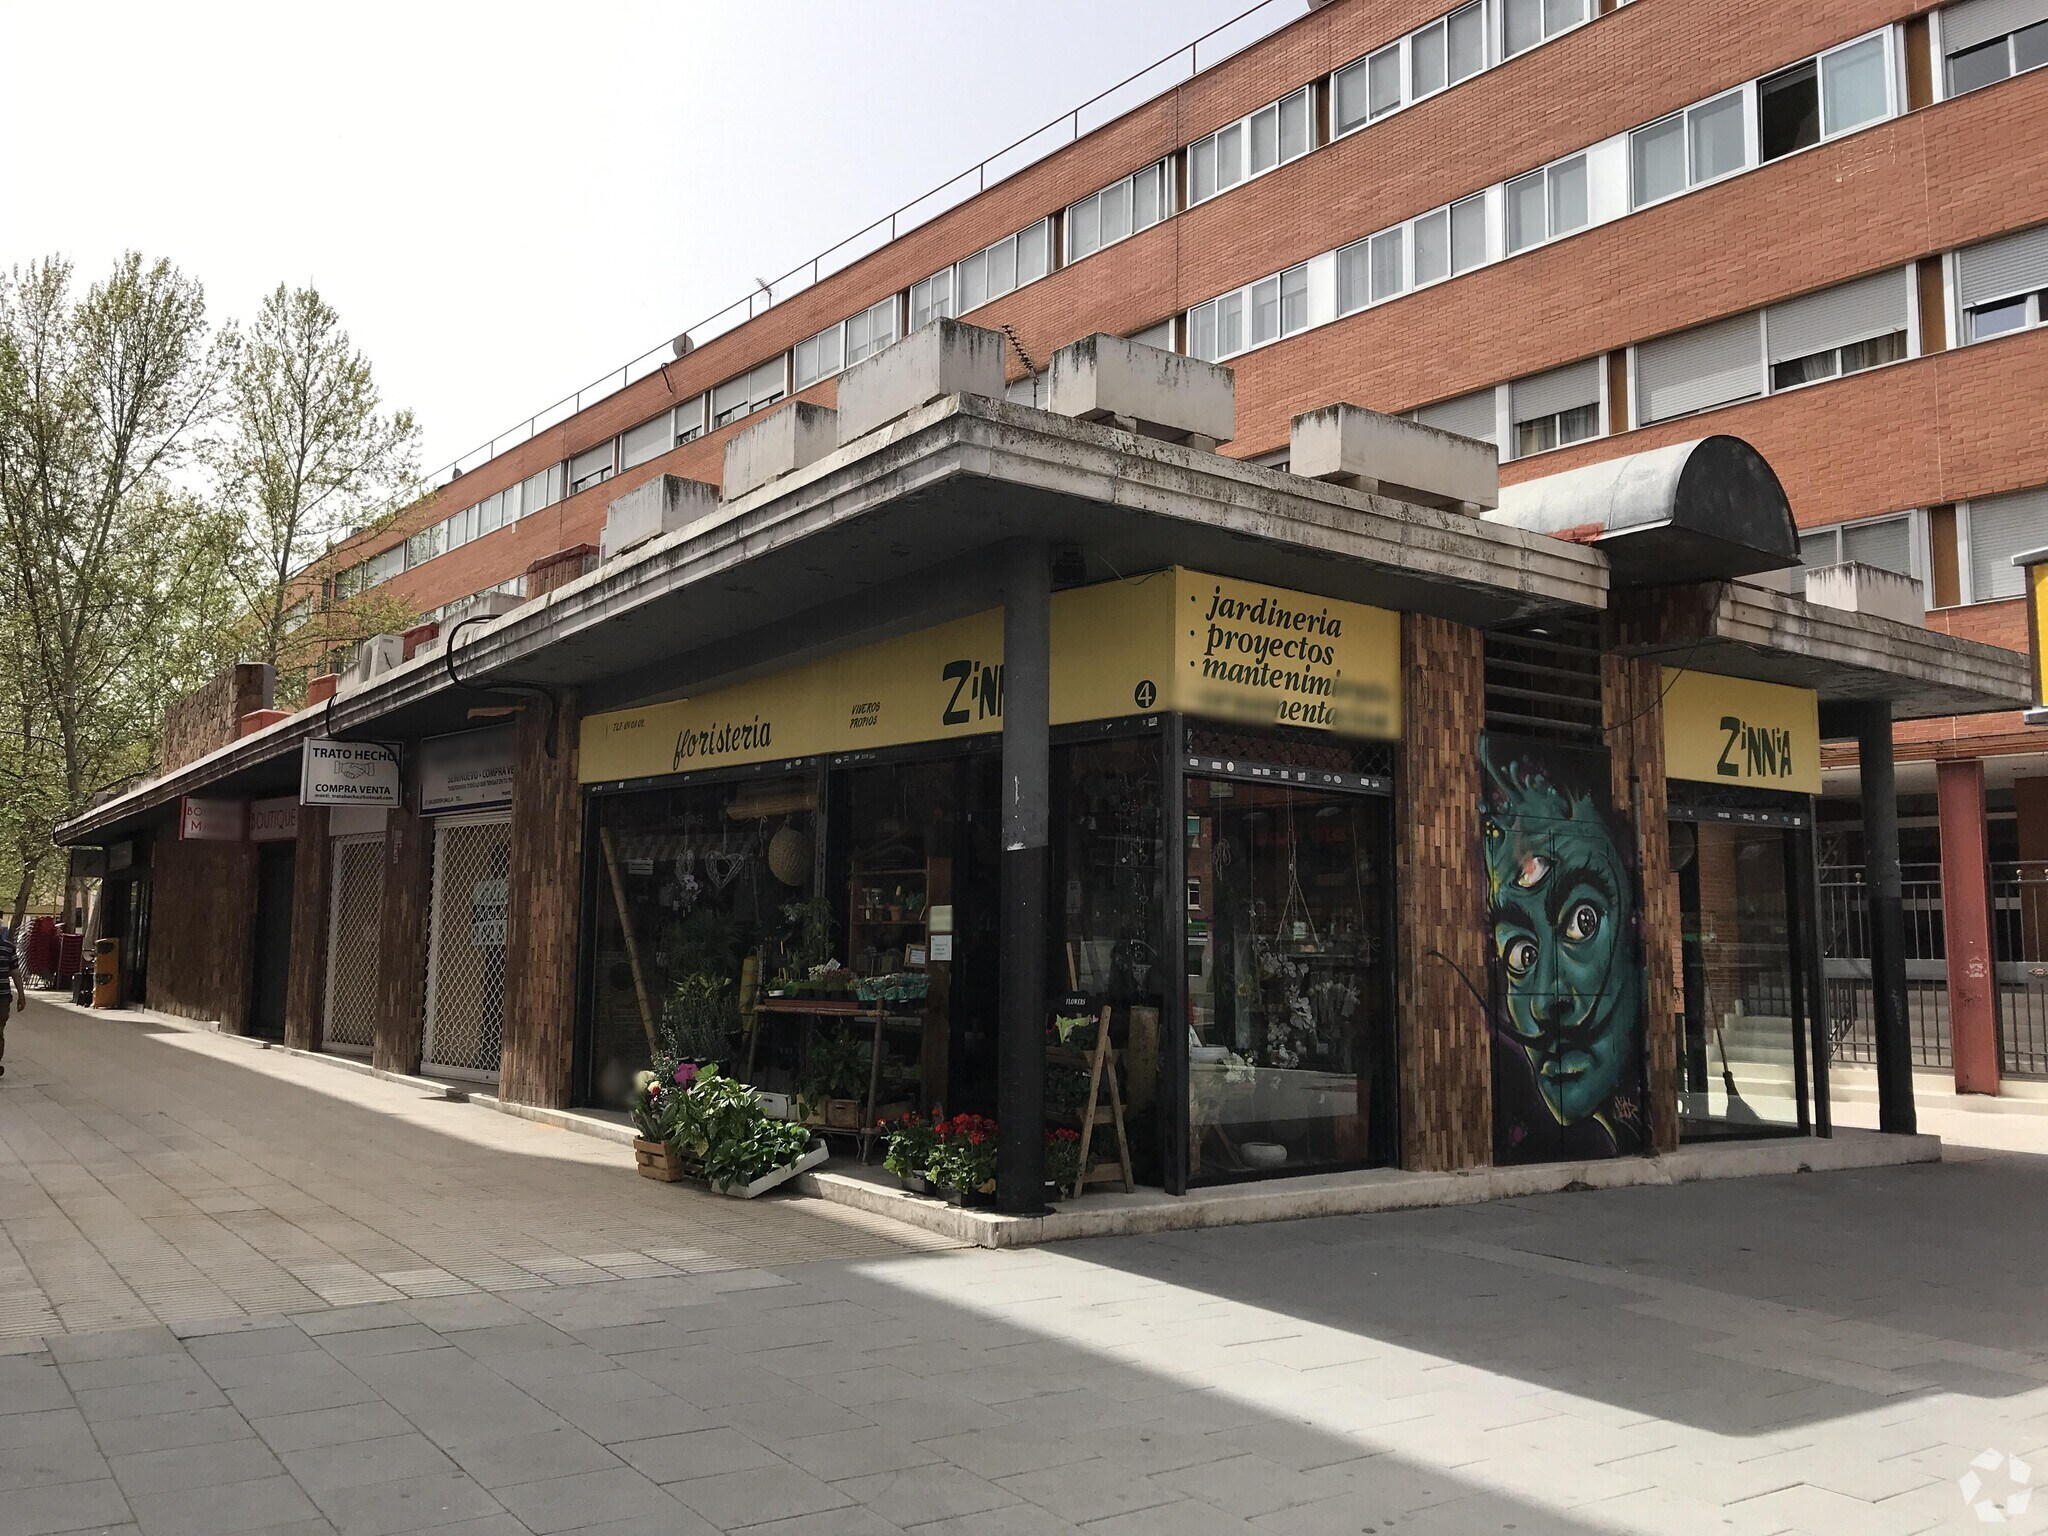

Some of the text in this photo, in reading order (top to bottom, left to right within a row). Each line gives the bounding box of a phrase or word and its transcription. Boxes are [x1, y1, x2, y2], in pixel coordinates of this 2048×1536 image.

[1205, 585, 1341, 638] jardineria
[1204, 623, 1334, 665] proyectos
[1202, 657, 1344, 698] mantenimi
[1137, 682, 1152, 707] 4
[851, 701, 881, 716] VIVEROS
[849, 715, 878, 729] PROPIOS
[313, 747, 397, 762] TRATO HECHO
[672, 714, 772, 772] floristeria
[482, 766, 506, 779] COMPRA
[315, 783, 391, 795] COMPRA VENTA
[250, 808, 297, 831] BOUTIQUE
